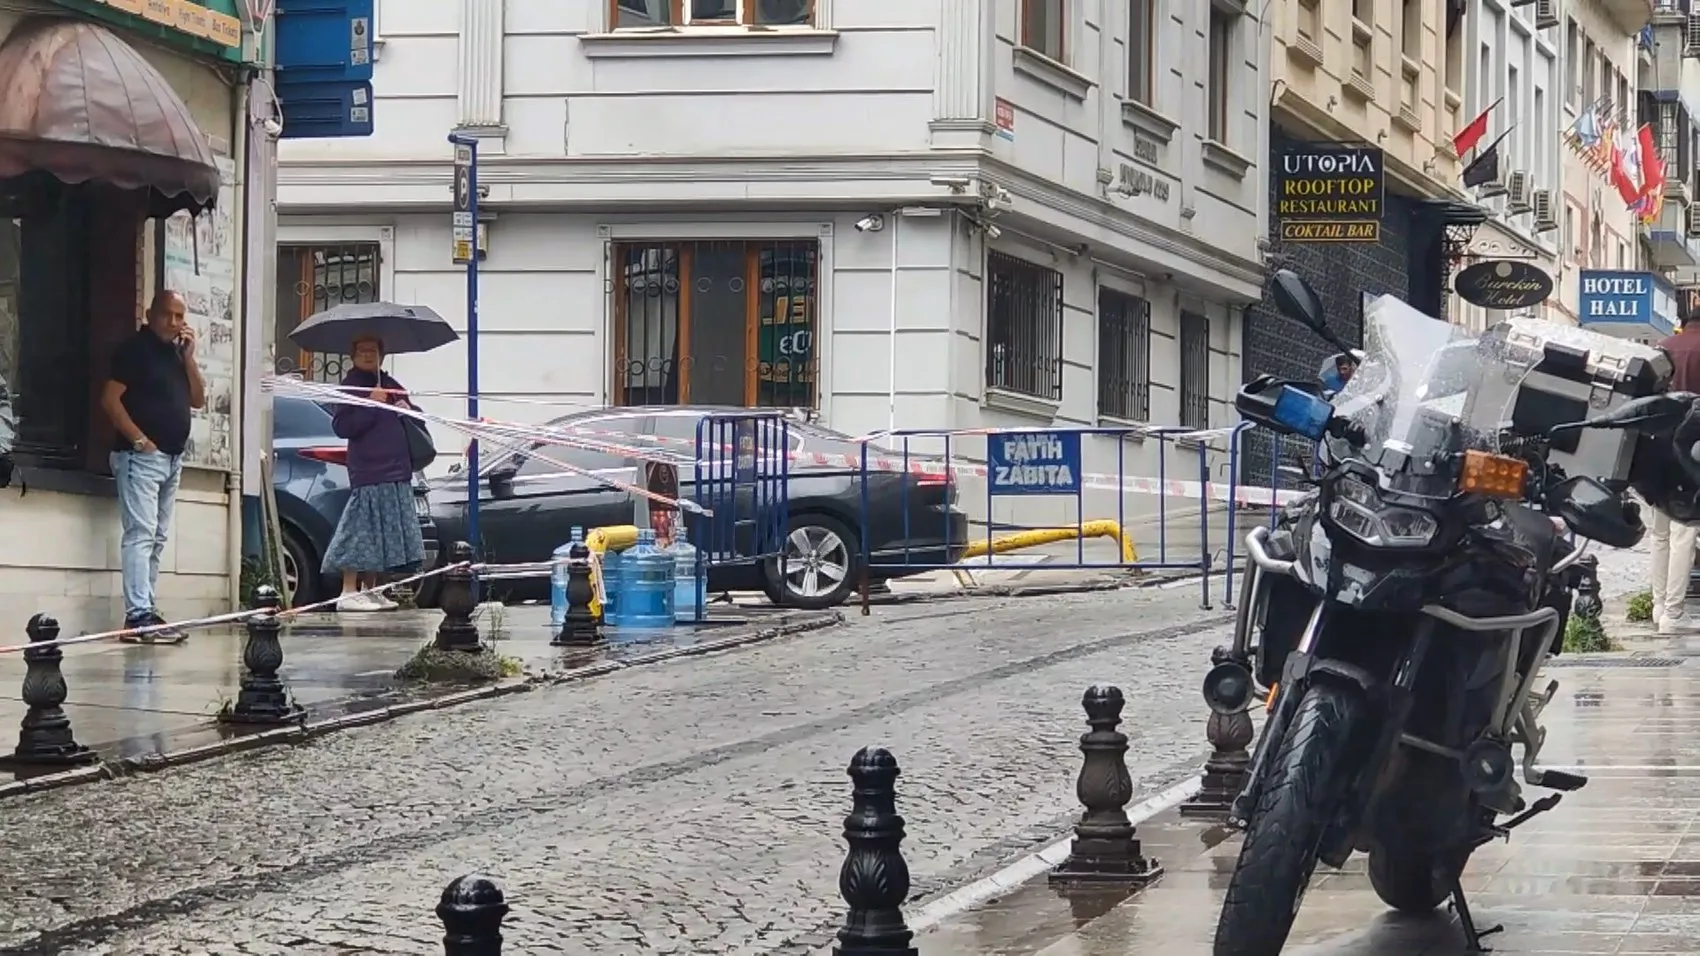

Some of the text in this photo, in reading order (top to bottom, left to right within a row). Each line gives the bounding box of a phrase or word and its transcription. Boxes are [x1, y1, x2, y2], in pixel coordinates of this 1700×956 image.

[1283, 154, 1375, 174] UTOPIA
[1285, 179, 1375, 195] ROOFTOP
[1280, 199, 1378, 213] RESTAURANT
[1285, 224, 1373, 237] COKTAIL BAR
[1584, 277, 1647, 295] HOTEL
[1482, 289, 1525, 305] Hotel
[1590, 301, 1638, 316] HALI
[995, 464, 1073, 486] ZABITA
